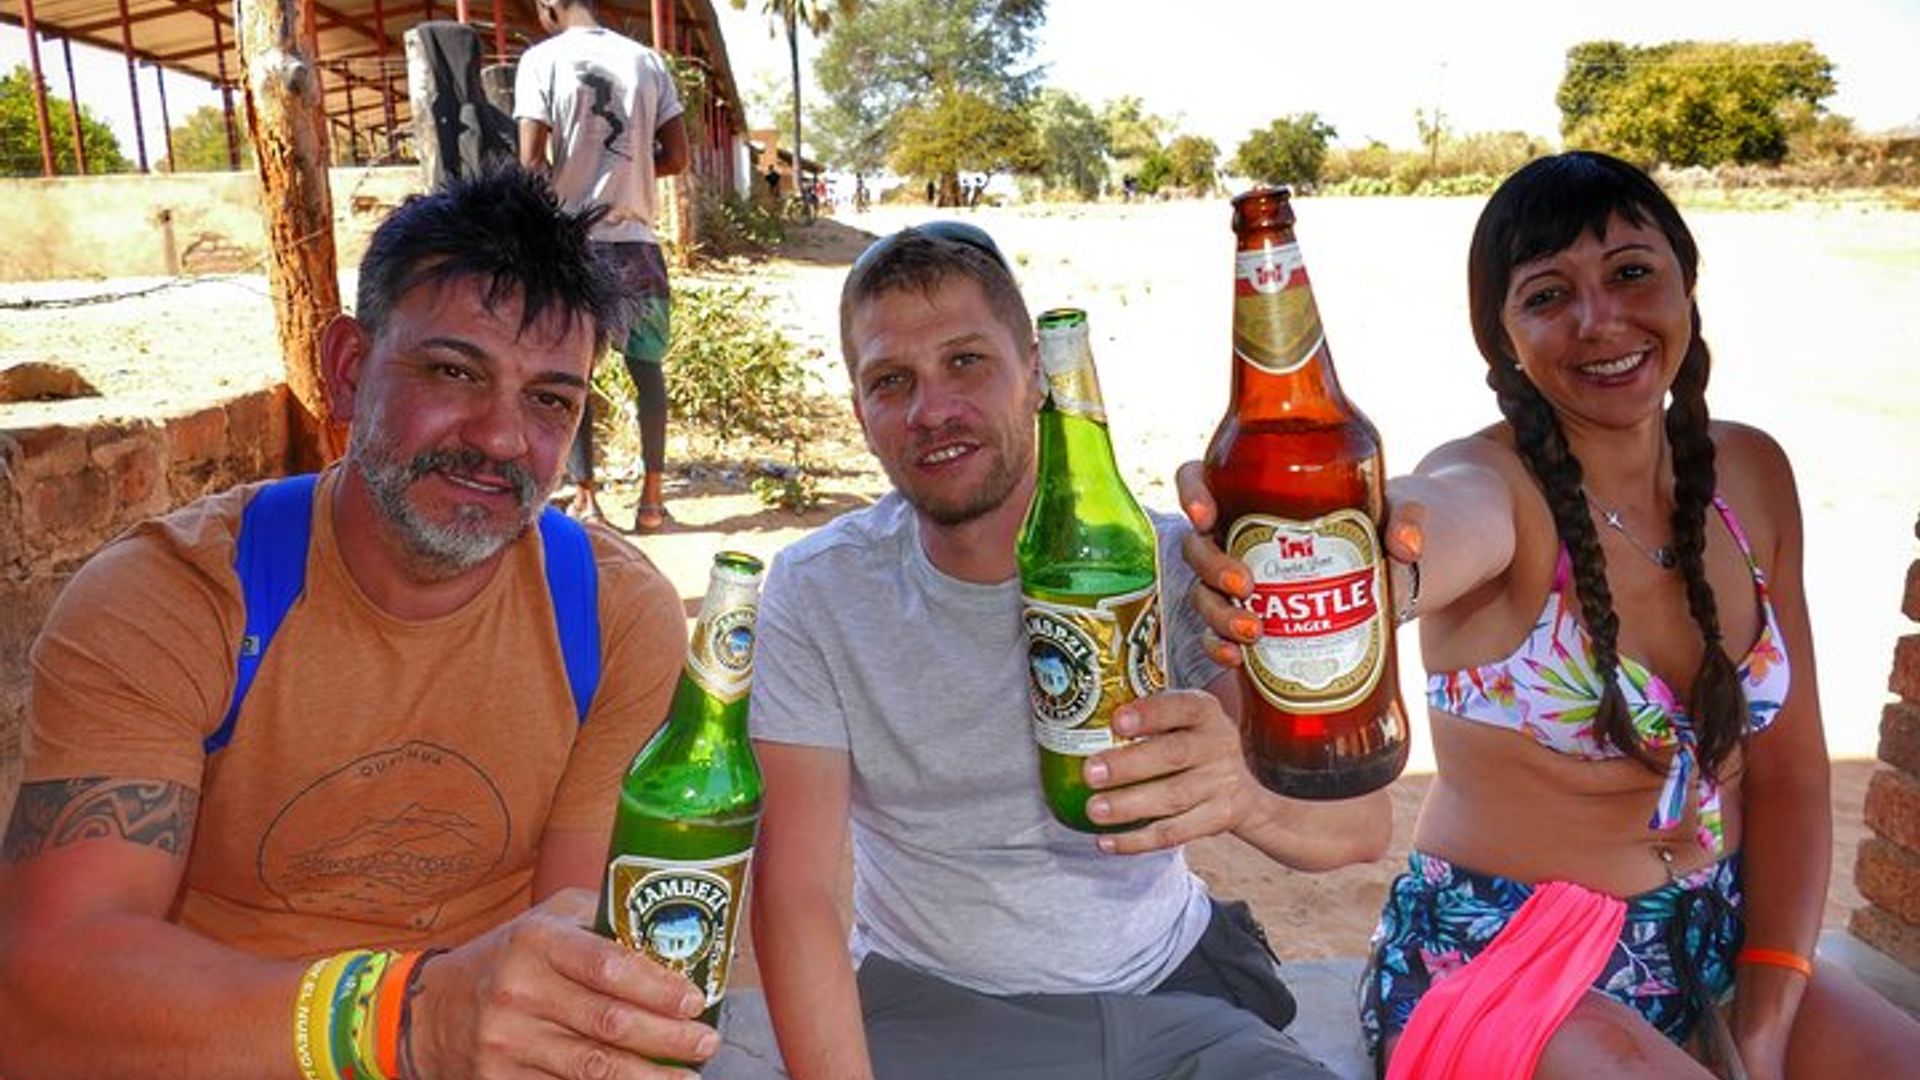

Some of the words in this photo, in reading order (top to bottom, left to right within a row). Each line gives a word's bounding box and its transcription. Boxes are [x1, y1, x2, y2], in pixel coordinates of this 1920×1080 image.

[1246, 580, 1368, 620] CASTLE
[1284, 620, 1332, 634] LAGER
[634, 879, 728, 915] ZAMBEZI
